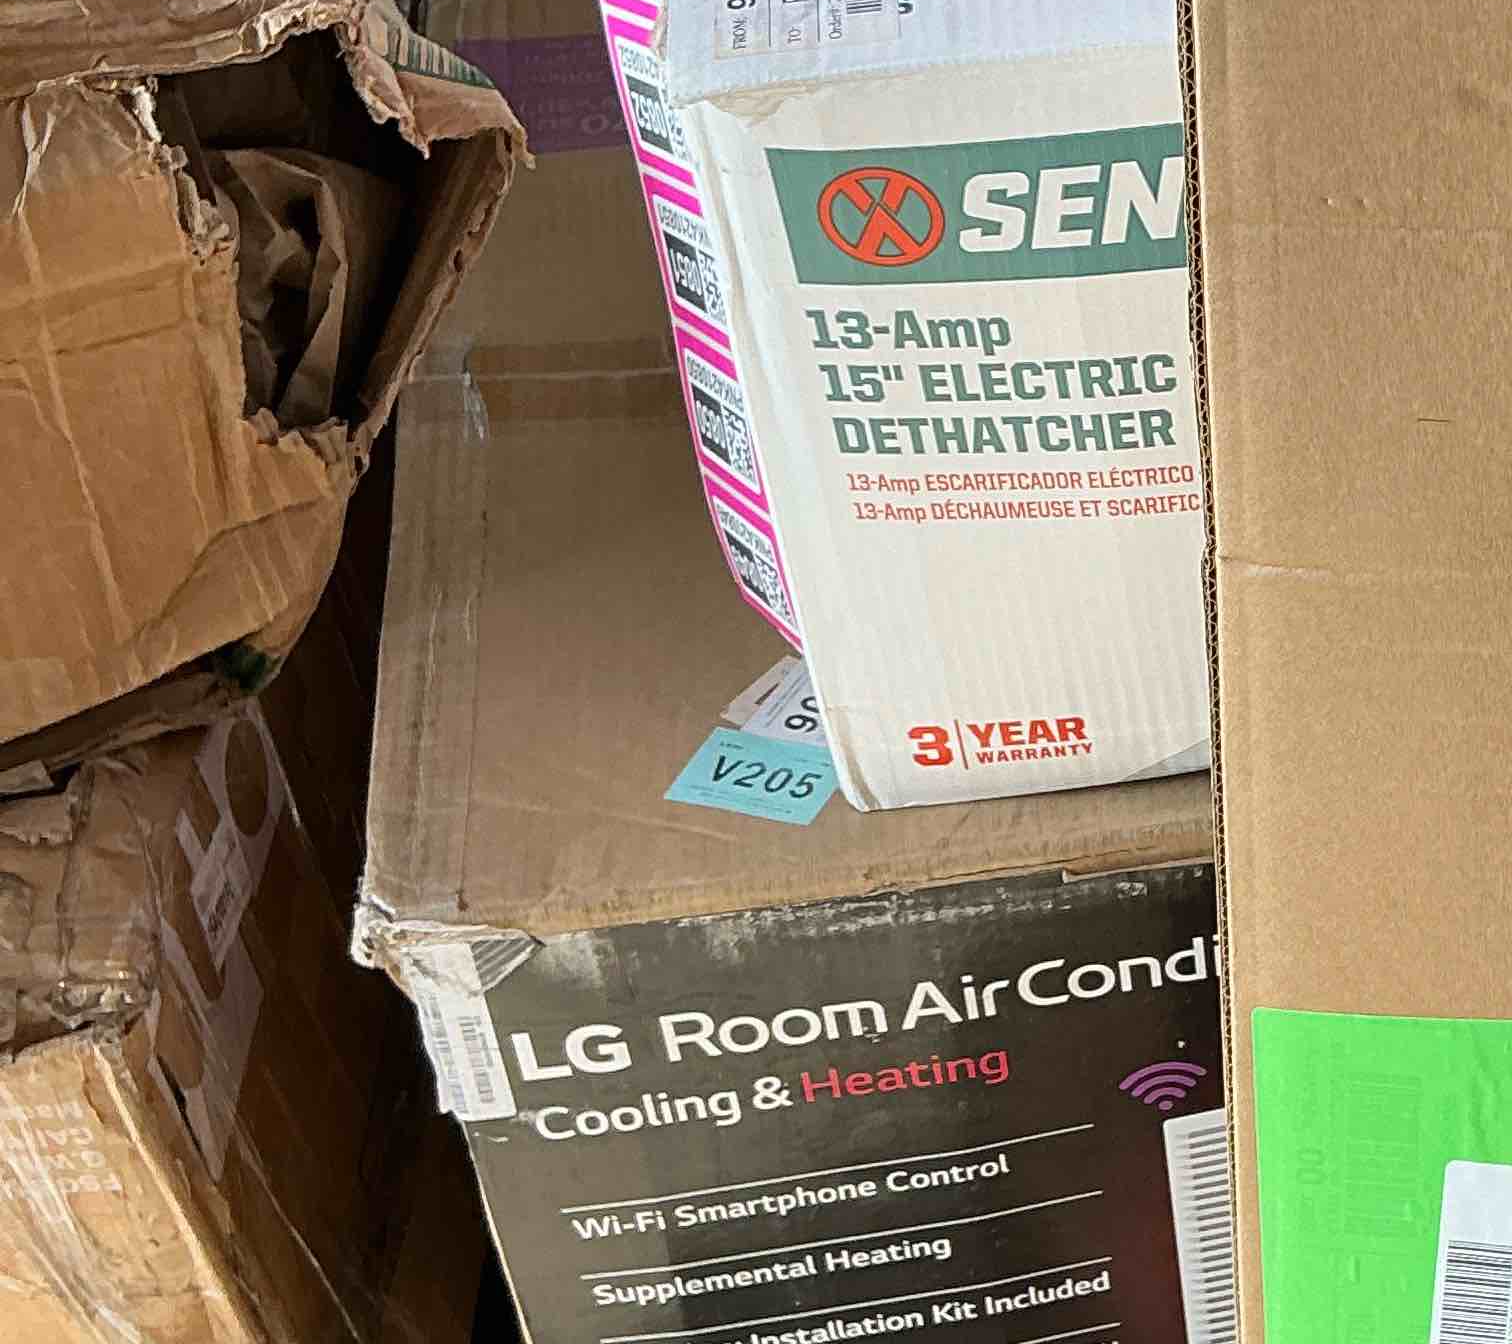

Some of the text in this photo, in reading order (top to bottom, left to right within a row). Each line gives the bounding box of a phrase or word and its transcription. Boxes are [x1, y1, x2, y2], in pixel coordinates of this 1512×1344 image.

[959, 156, 1186, 253] SEN
[806, 309, 1011, 355] 13-Amp
[819, 354, 1177, 403] 15" ELECTRIC
[832, 409, 1177, 455] DETHATCHER
[847, 464, 1194, 494] 13-Amp ESCARIFICADOR ELÉCTRICO
[855, 492, 1201, 524] 13-Amp DÉCHAUMEUSE ET SCARIFIC
[907, 716, 1089, 767] 3 YEAR
[976, 742, 1094, 765] WARRANTY
[712, 754, 823, 799] V205
[509, 1023, 632, 1082] LG
[659, 998, 886, 1062] Room
[903, 975, 1008, 1031] Air
[1016, 935, 1222, 1009] Condi
[536, 1045, 1011, 1142] Cooling & Heating
[573, 1153, 1010, 1240] Wi-Fi Smartphone Control
[592, 1233, 953, 1308] Supplemental Heating
[932, 1296, 979, 1325] Kit
[985, 1270, 1112, 1316] Included
